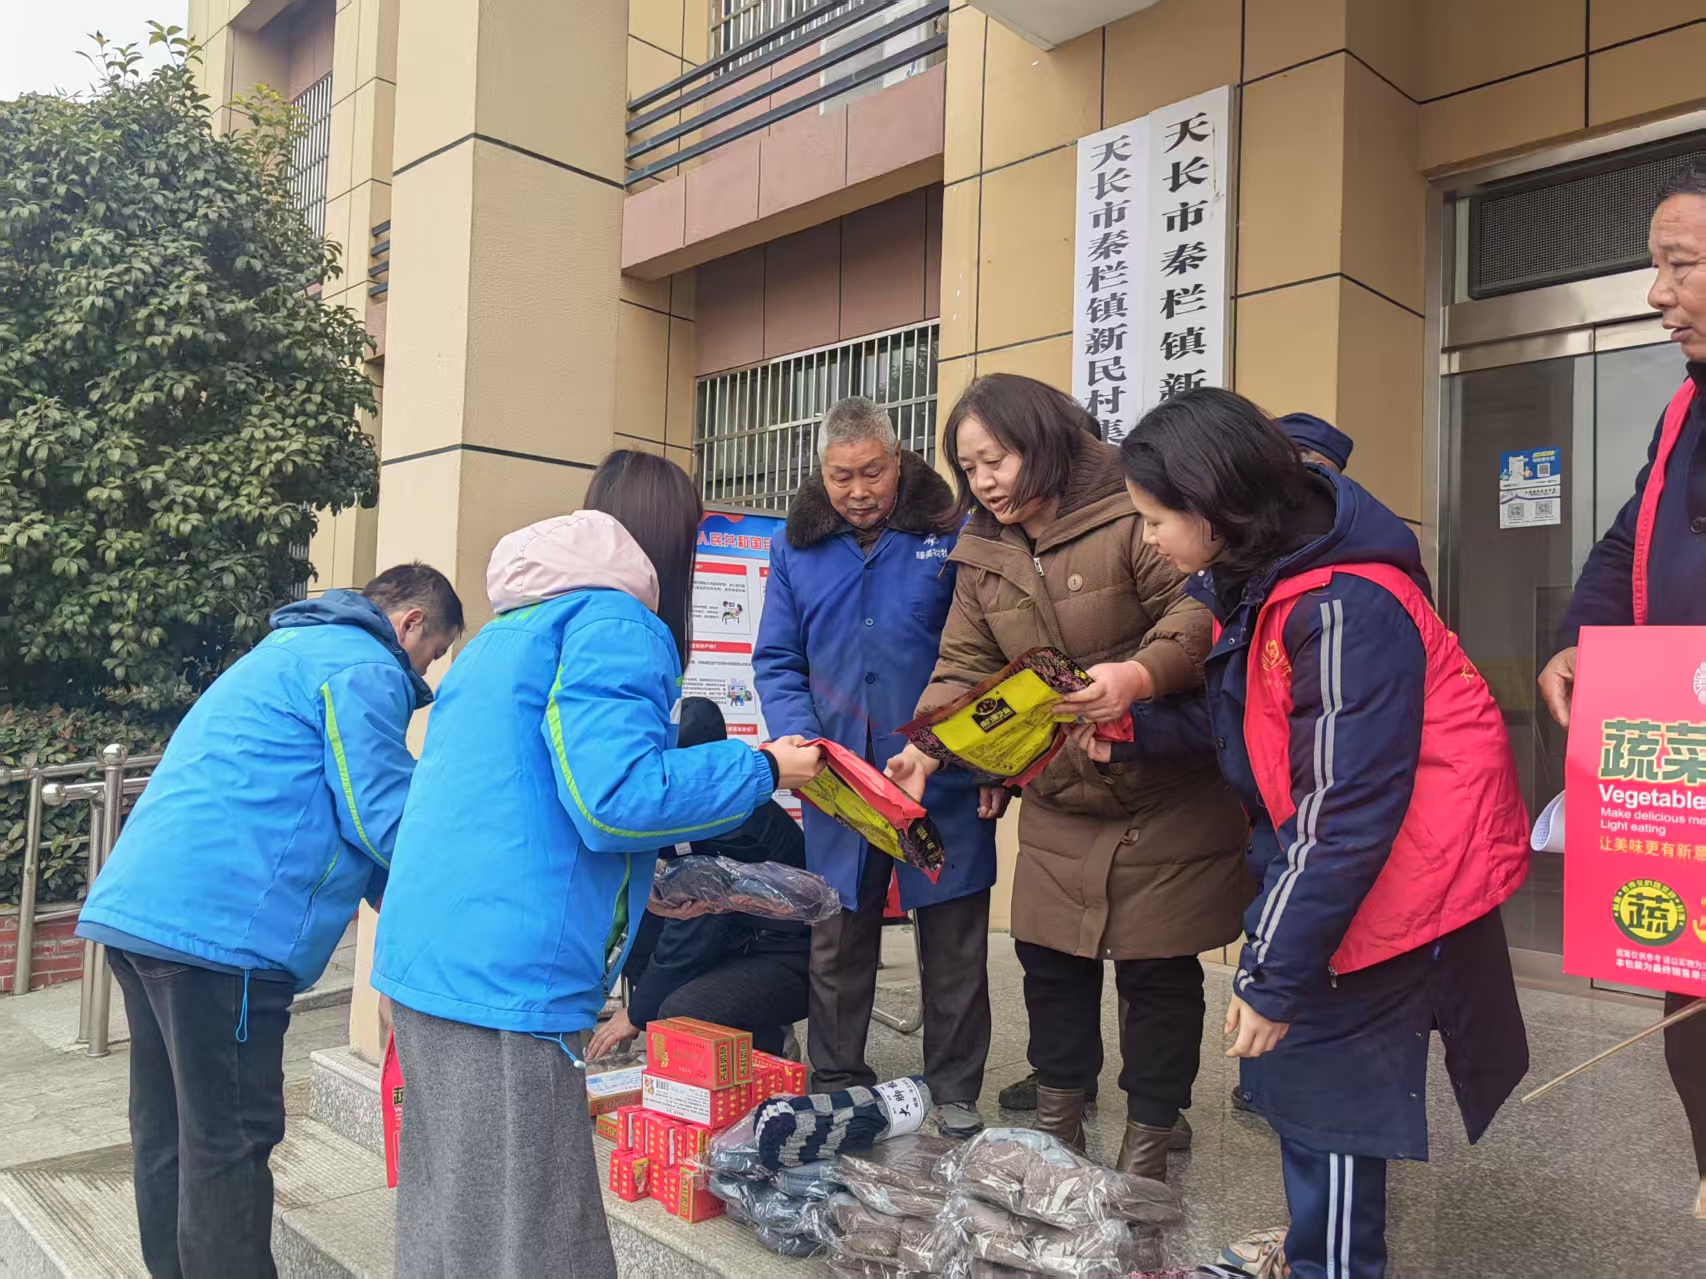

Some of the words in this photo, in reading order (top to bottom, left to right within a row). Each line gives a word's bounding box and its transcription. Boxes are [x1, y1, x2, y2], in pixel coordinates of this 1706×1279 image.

[1600, 807, 1631, 819] Make
[1634, 810, 1685, 824] delicious
[1600, 819, 1628, 832] Light
[1630, 823, 1666, 837] eating
